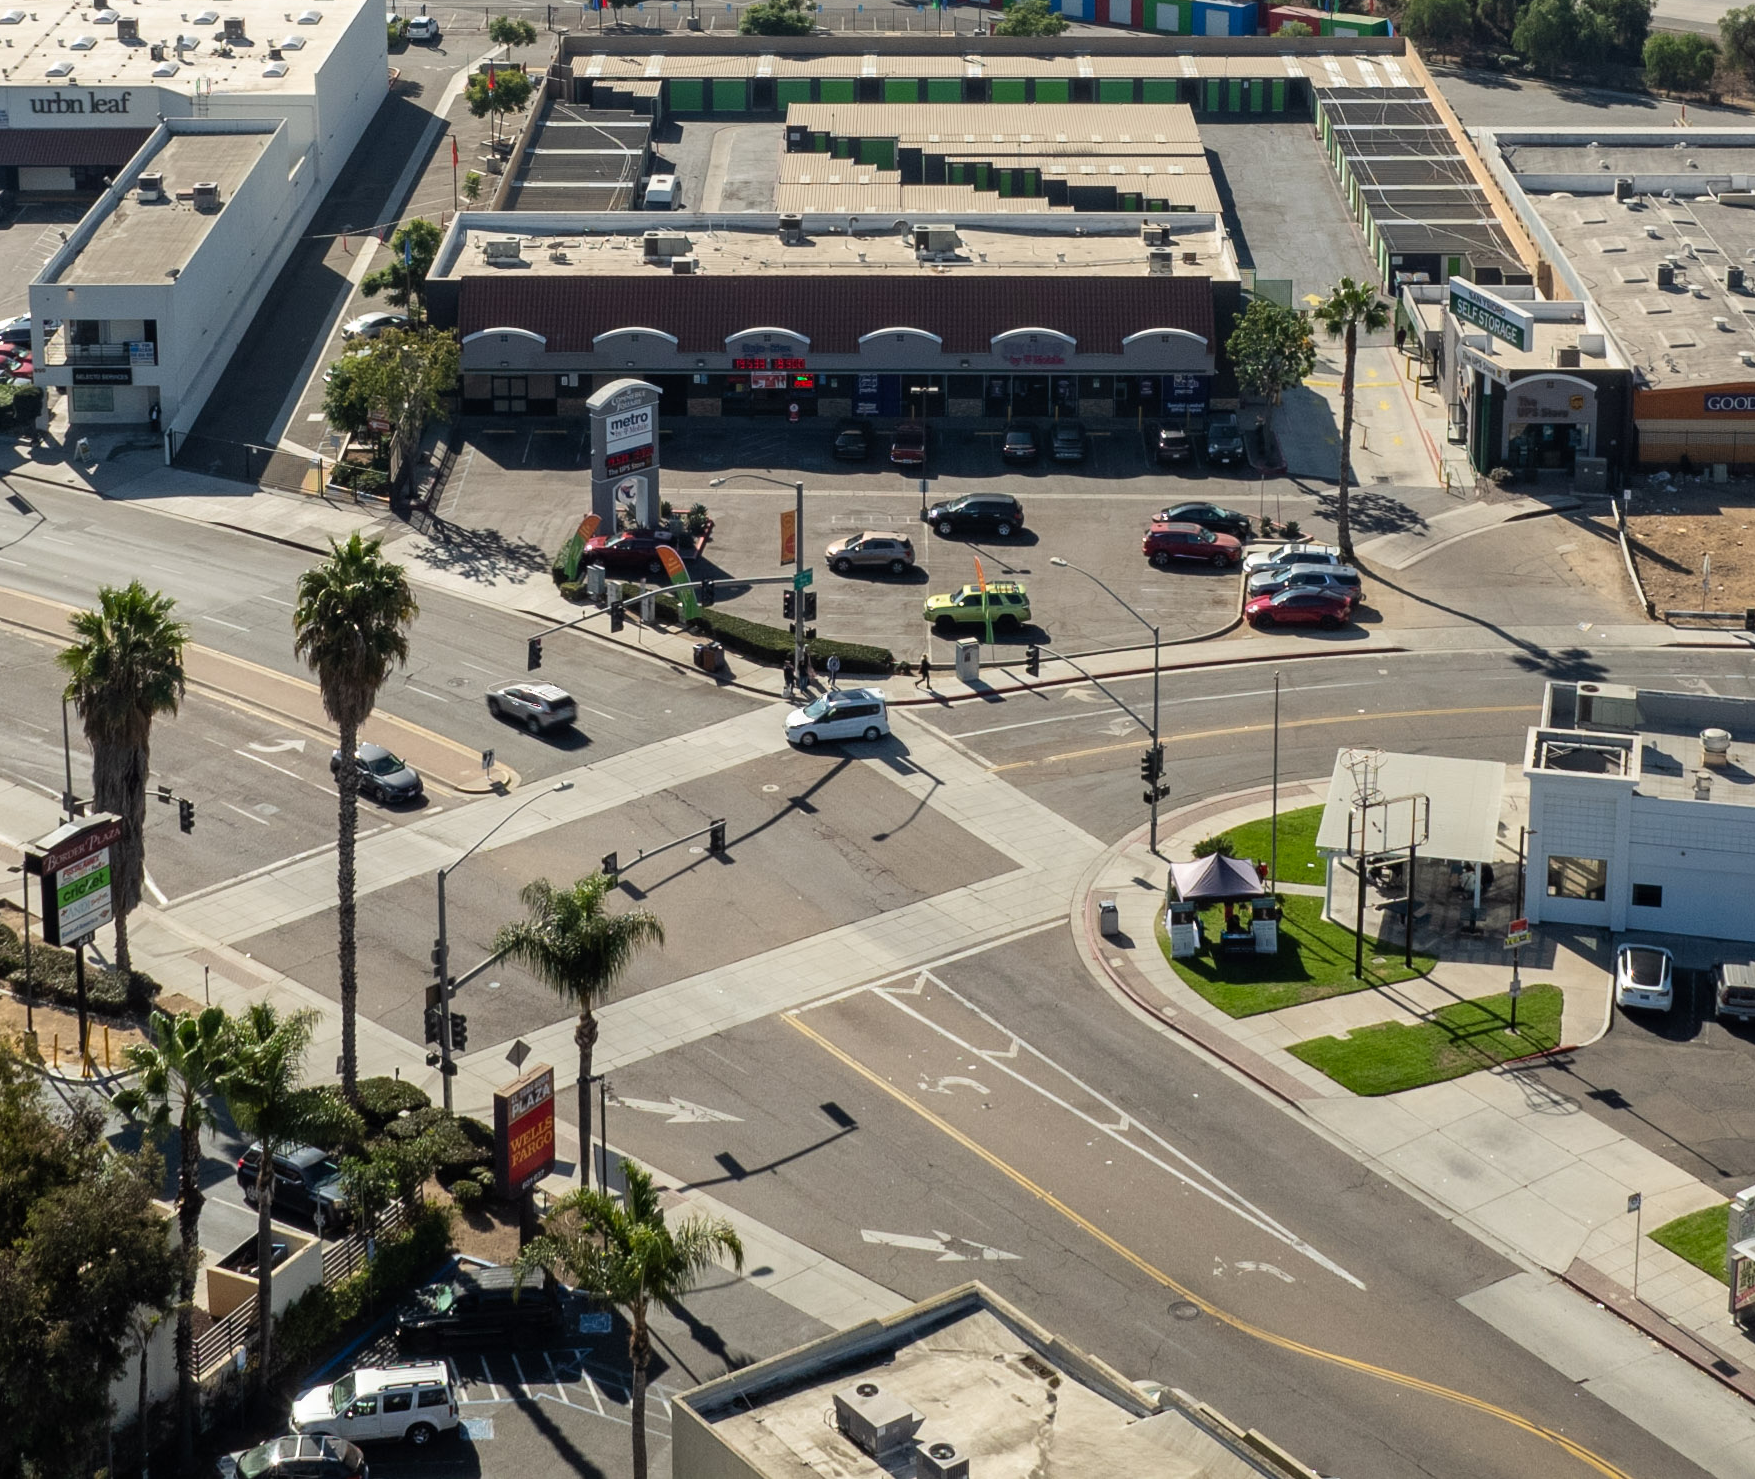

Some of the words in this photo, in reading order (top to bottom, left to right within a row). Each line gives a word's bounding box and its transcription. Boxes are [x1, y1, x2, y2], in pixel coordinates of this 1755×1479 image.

[30, 94, 84, 114] urbn
[87, 92, 132, 114] leaf
[1457, 299, 1478, 321] SELF
[1478, 312, 1518, 343] STORAGE
[611, 412, 649, 430] metro
[45, 846, 87, 871] BORDER
[87, 826, 122, 851] PLAZA
[62, 872, 106, 903] cricket
[511, 1083, 551, 1119] PLAZA
[510, 1116, 553, 1152] WELLS
[511, 1131, 553, 1168] FARGO
